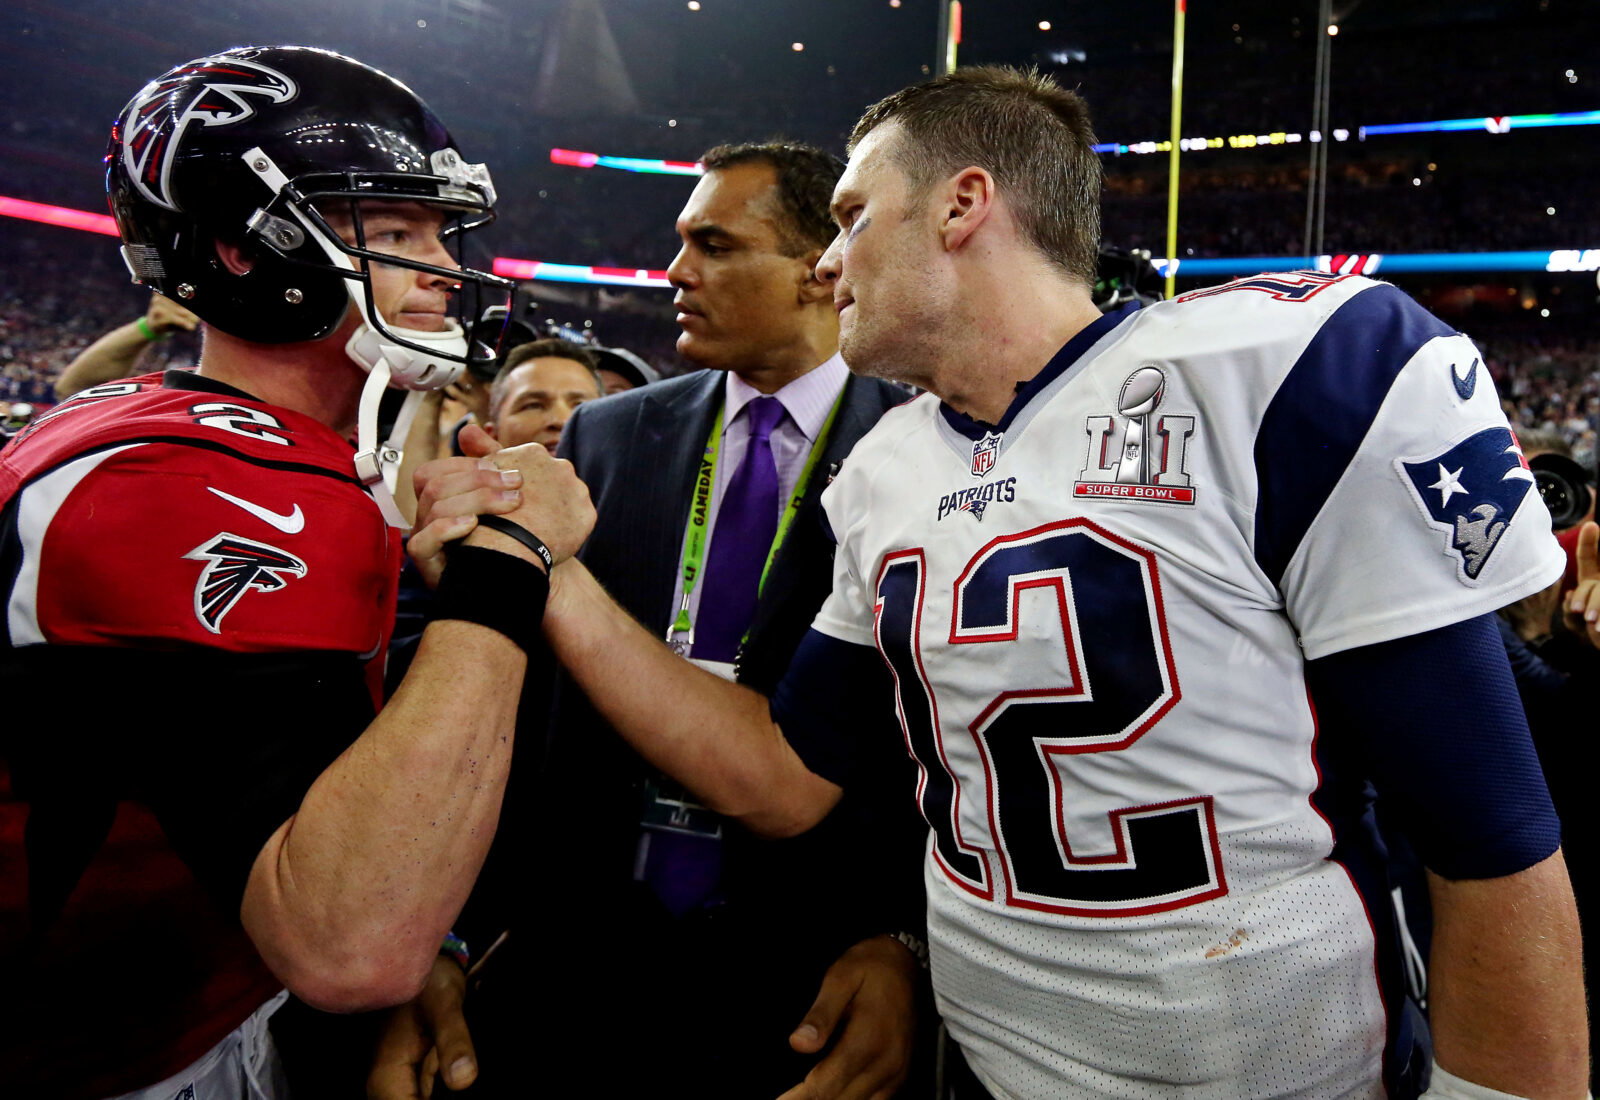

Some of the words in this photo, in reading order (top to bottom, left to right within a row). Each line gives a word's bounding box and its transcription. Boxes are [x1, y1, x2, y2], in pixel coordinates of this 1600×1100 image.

[187, 402, 295, 446] 2
[972, 451, 996, 475] NFL
[1080, 415, 1196, 487] LI
[693, 460, 713, 526] GAMEDAY
[937, 477, 1017, 521] PATRIOTS
[1086, 485, 1129, 496] SUPER
[1135, 487, 1176, 499] BOWL
[873, 516, 1229, 918] 12
